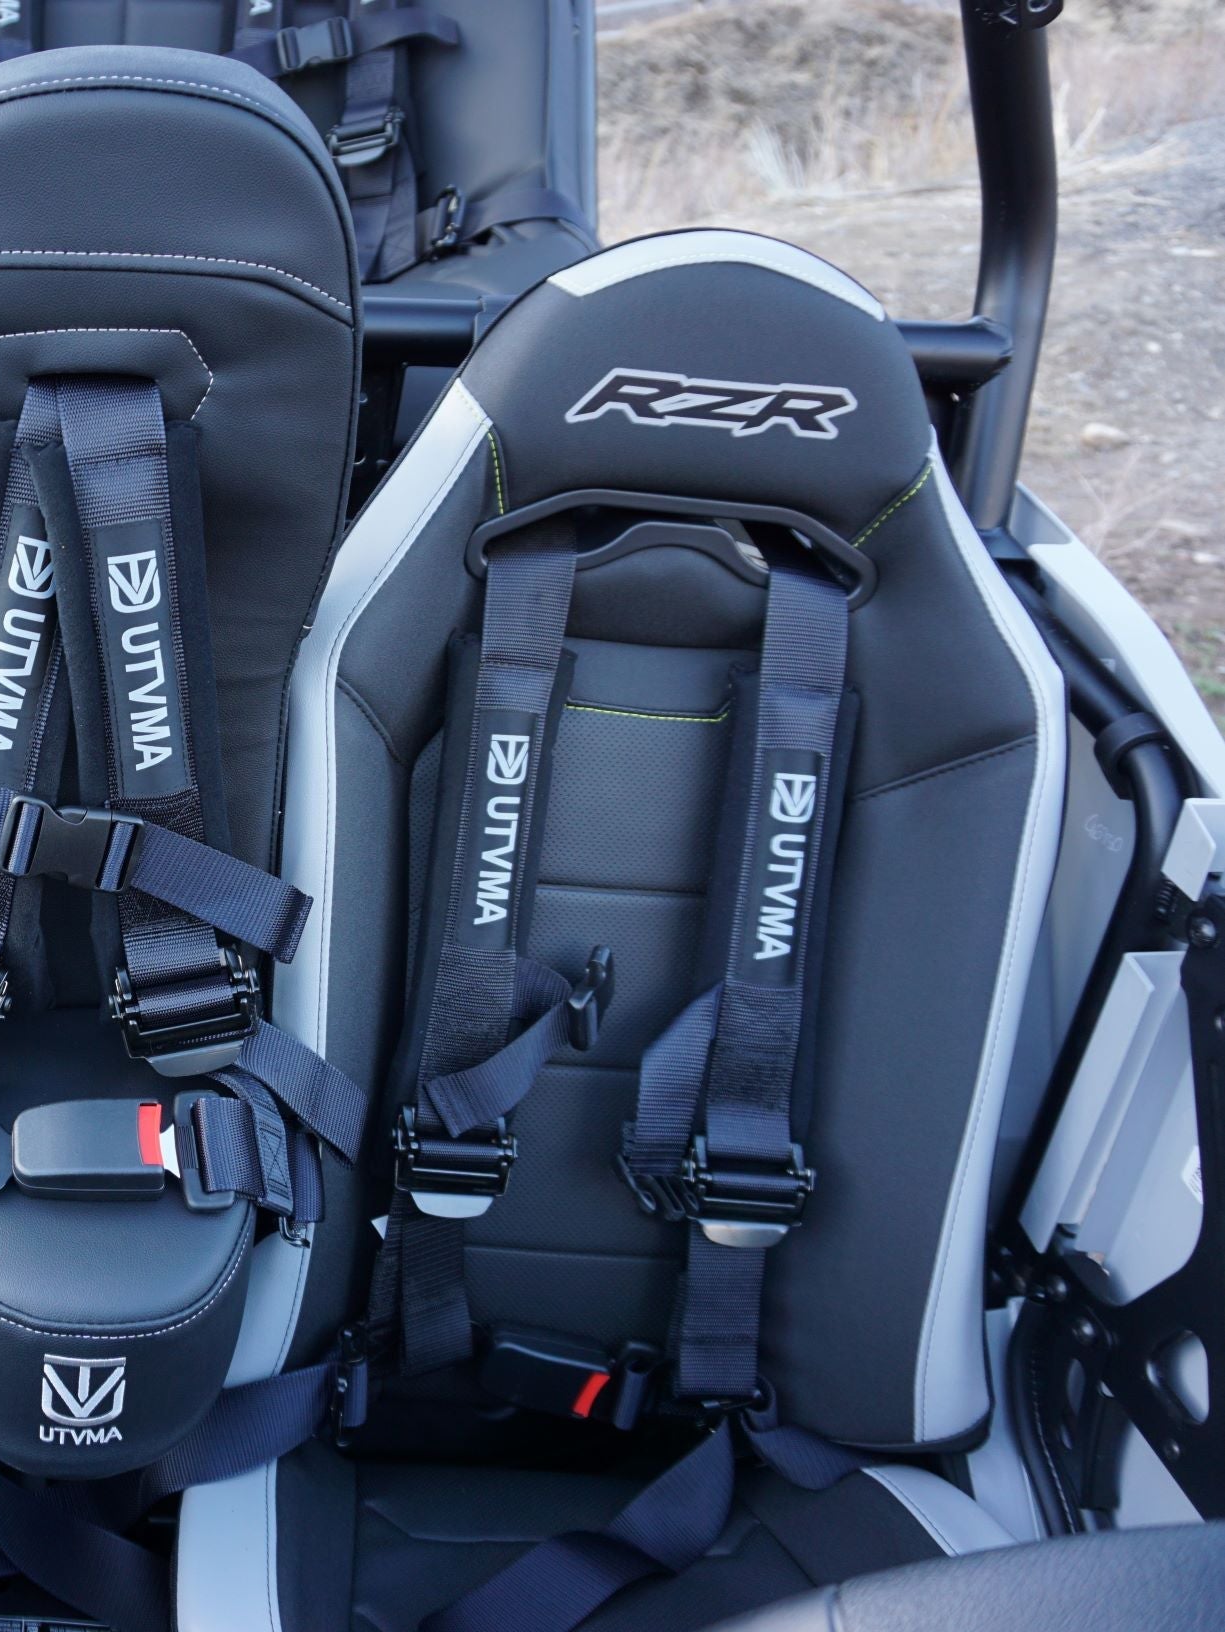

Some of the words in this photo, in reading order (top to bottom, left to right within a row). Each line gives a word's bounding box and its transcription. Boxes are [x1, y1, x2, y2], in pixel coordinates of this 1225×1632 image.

[565, 368, 857, 439] RZR
[122, 622, 172, 770] UTVMA
[474, 797, 520, 924] UTVMA
[754, 834, 805, 959] UTVMA
[40, 1425, 122, 1445] UTVMA
